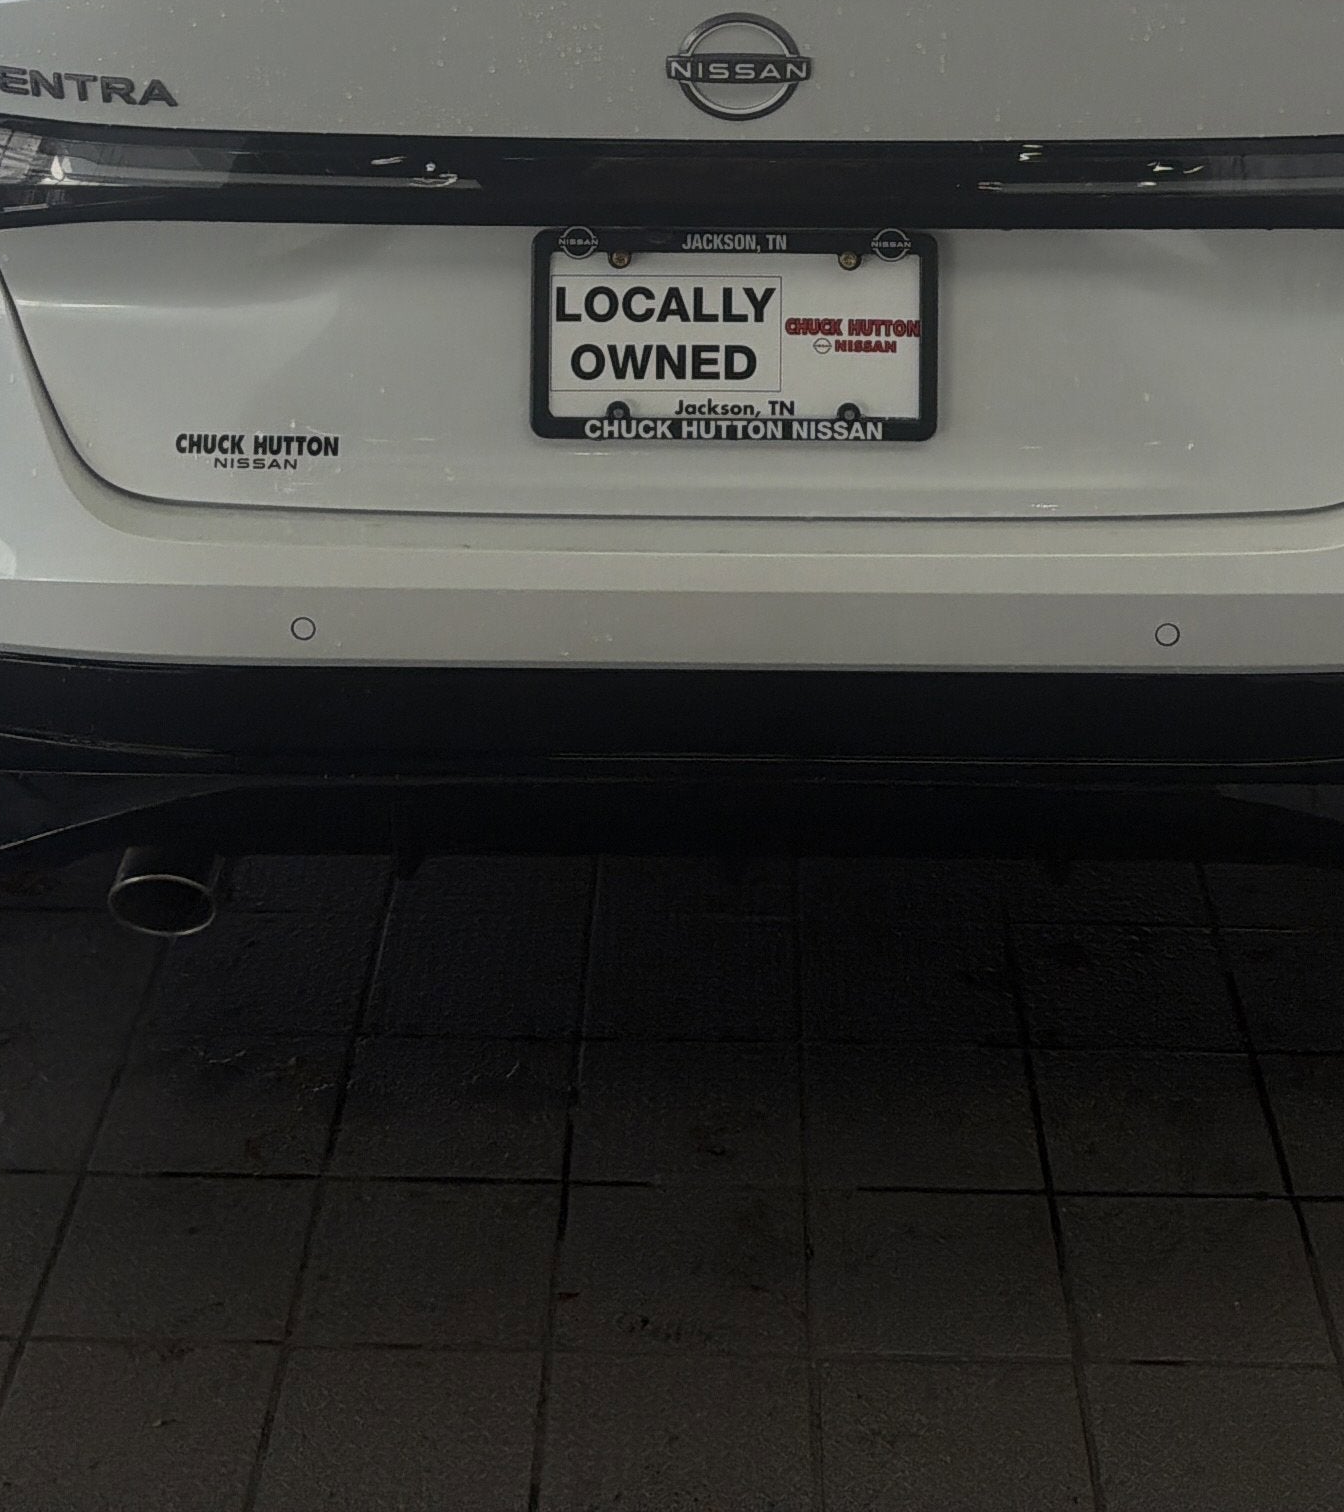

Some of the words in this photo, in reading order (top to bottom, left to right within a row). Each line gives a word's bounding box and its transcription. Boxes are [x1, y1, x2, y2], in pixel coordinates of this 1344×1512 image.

[670, 62, 807, 79] NISSAN
[558, 238, 599, 246] NISSAN
[682, 234, 761, 253] JACKSON,
[766, 234, 786, 250] TN
[555, 287, 776, 323] LOCALLY
[785, 317, 843, 337] CHUCK
[848, 320, 921, 338] HUTTON
[835, 340, 897, 354] NISSAN
[571, 344, 757, 381] OWNED
[675, 399, 760, 417] Jackson,
[768, 401, 795, 416] TN
[584, 420, 673, 439] CHUCK
[680, 420, 784, 440] HUTTON
[792, 421, 884, 440] NISSAN
[176, 434, 245, 455] CHUCK
[253, 435, 339, 456] HUTTON
[214, 458, 298, 470] NISSAN
